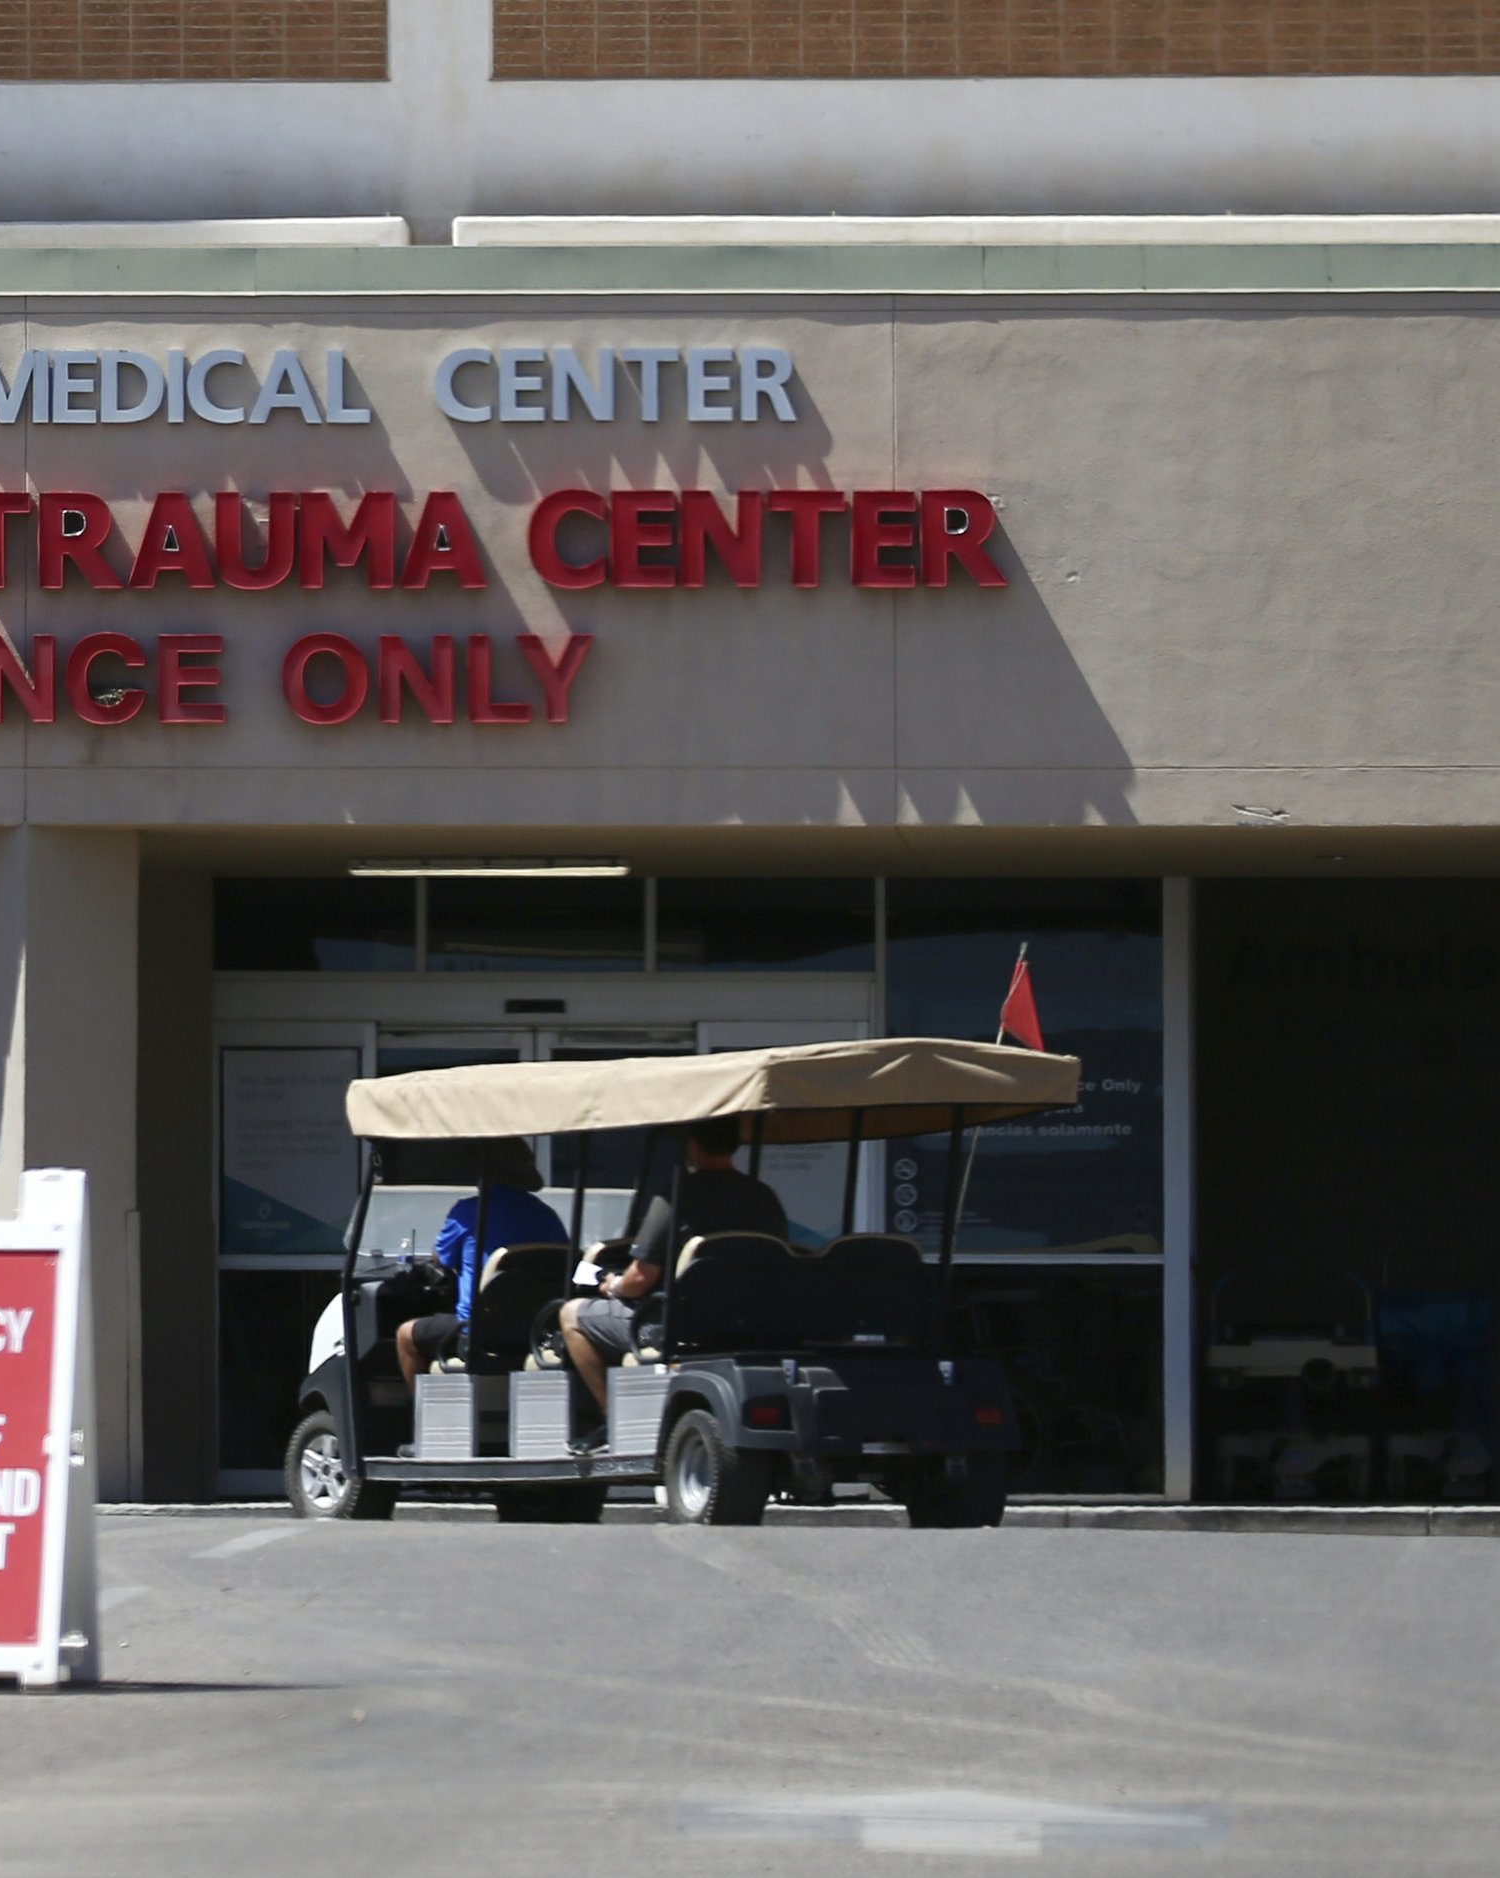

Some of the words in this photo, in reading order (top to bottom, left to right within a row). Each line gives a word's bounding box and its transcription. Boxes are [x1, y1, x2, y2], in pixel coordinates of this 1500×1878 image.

[433, 344, 797, 423] CENTER
[527, 487, 1008, 591] CENTER
[282, 632, 594, 727] ONLY
[1102, 1078, 1141, 1094] Only
[1038, 1122, 1132, 1136] solamente
